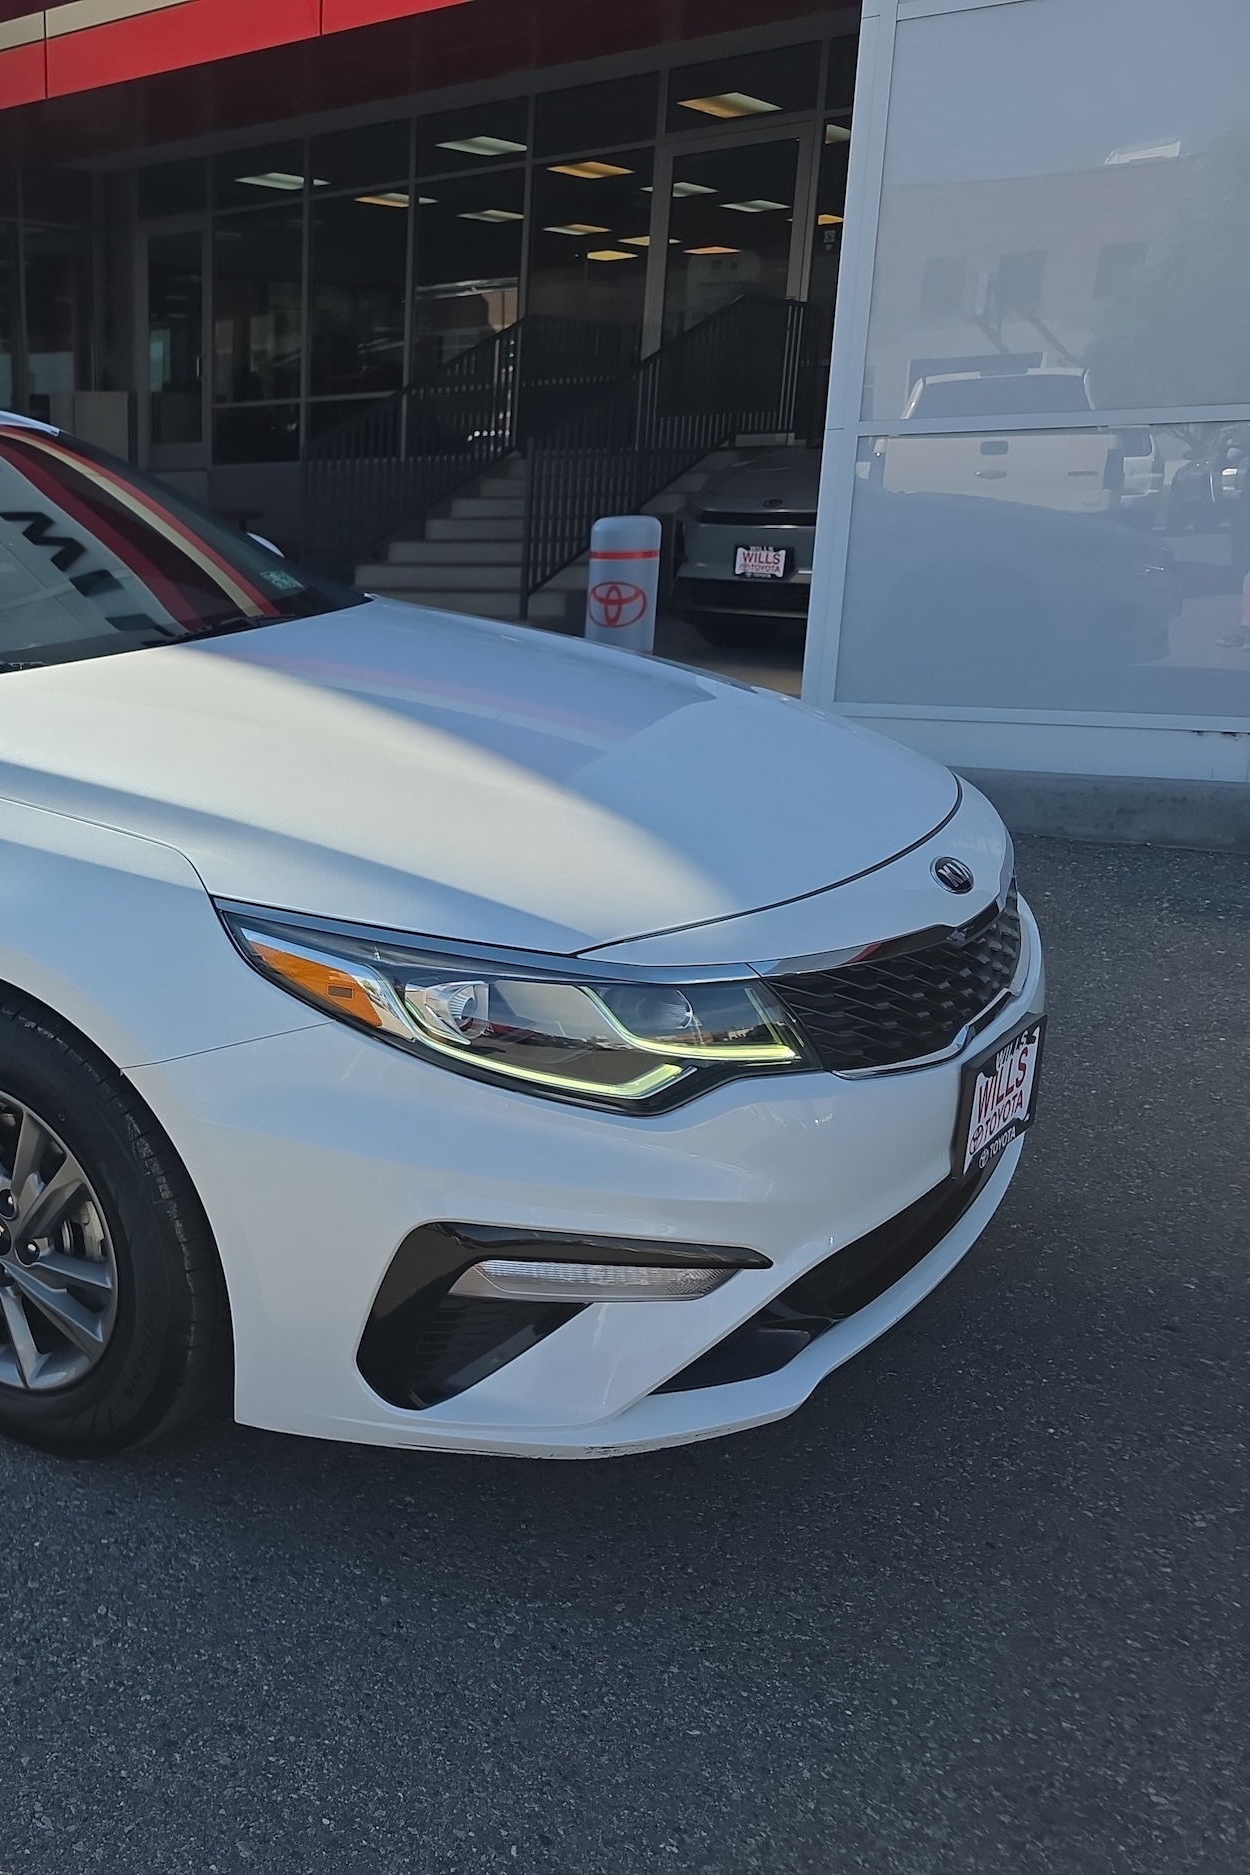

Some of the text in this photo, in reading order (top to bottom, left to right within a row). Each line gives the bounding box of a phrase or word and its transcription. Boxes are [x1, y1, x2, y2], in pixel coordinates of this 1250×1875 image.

[742, 551, 781, 565] WILLS
[977, 1046, 1029, 1124] WILLS
[983, 1089, 1023, 1142] TOYOTA
[989, 1125, 1017, 1158] TOYOTA
